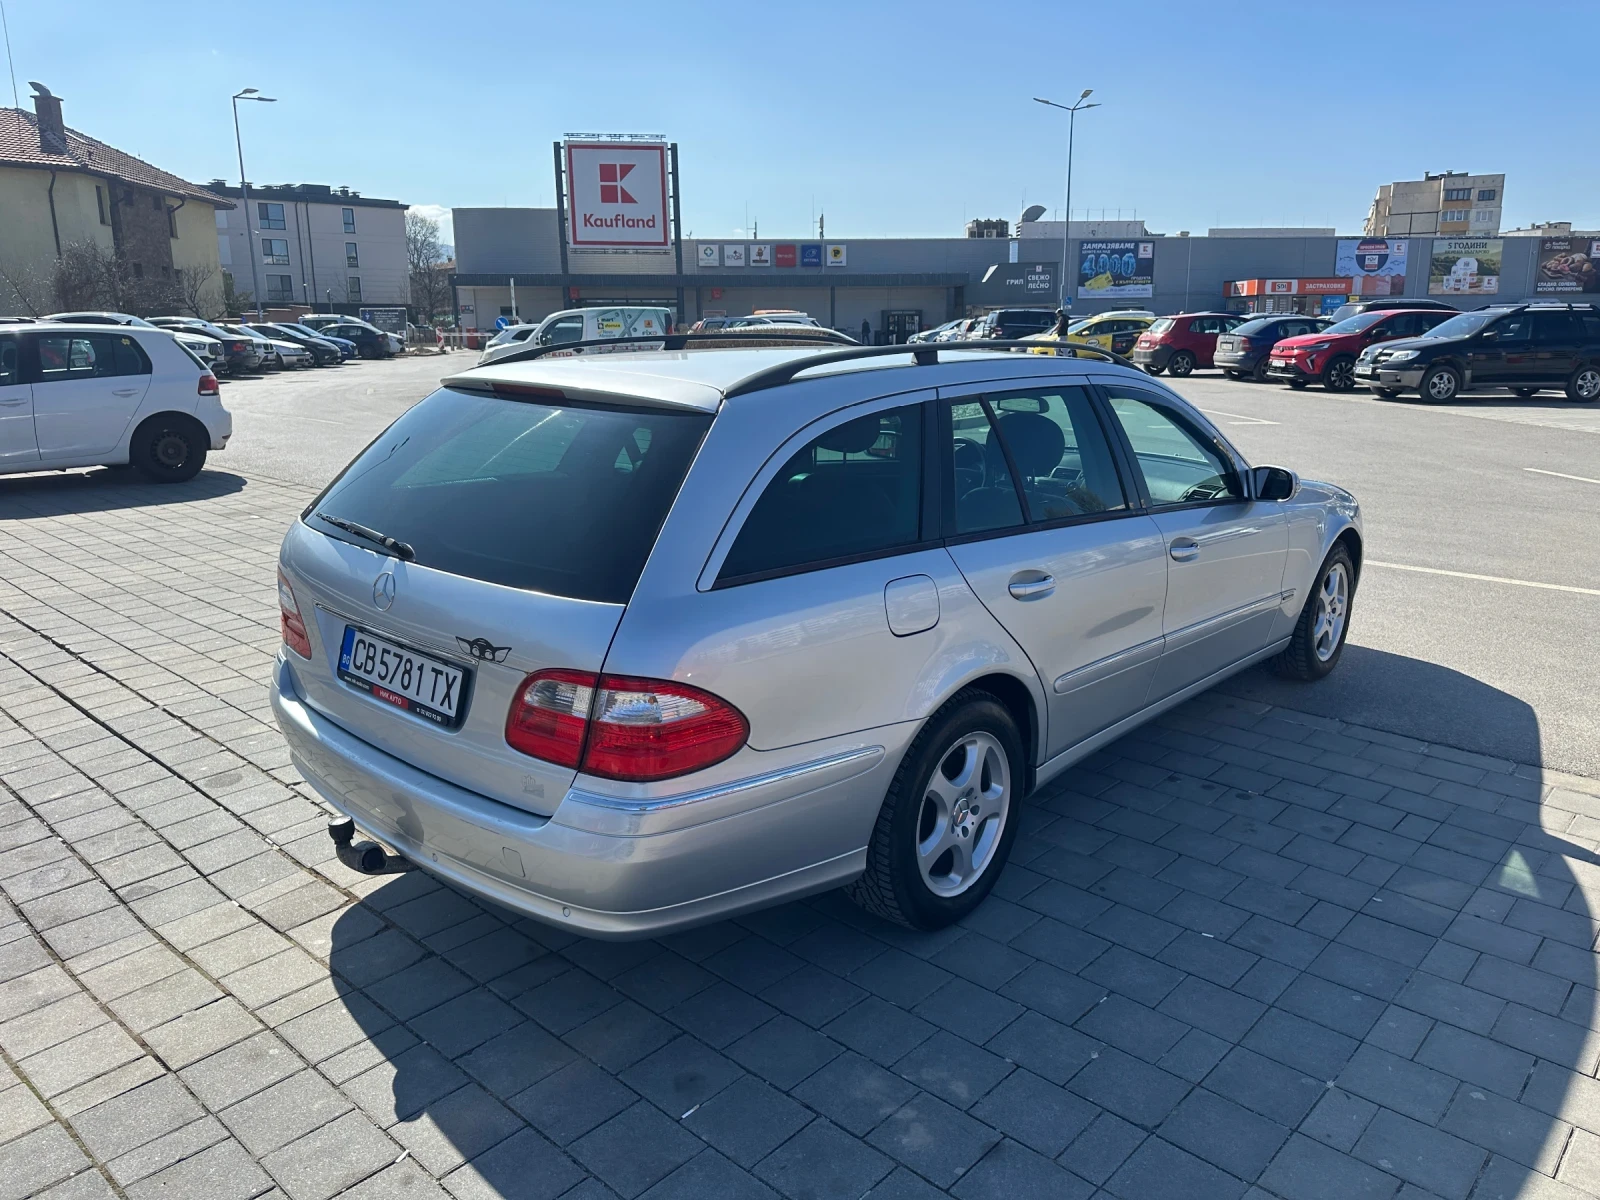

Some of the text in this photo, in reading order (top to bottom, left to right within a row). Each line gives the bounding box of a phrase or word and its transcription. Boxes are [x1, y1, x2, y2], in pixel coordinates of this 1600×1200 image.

[584, 214, 656, 228] Kaufland
[1081, 253, 1136, 277] 4000
[342, 653, 350, 665] BG
[353, 638, 458, 711] CB 5781 TX
